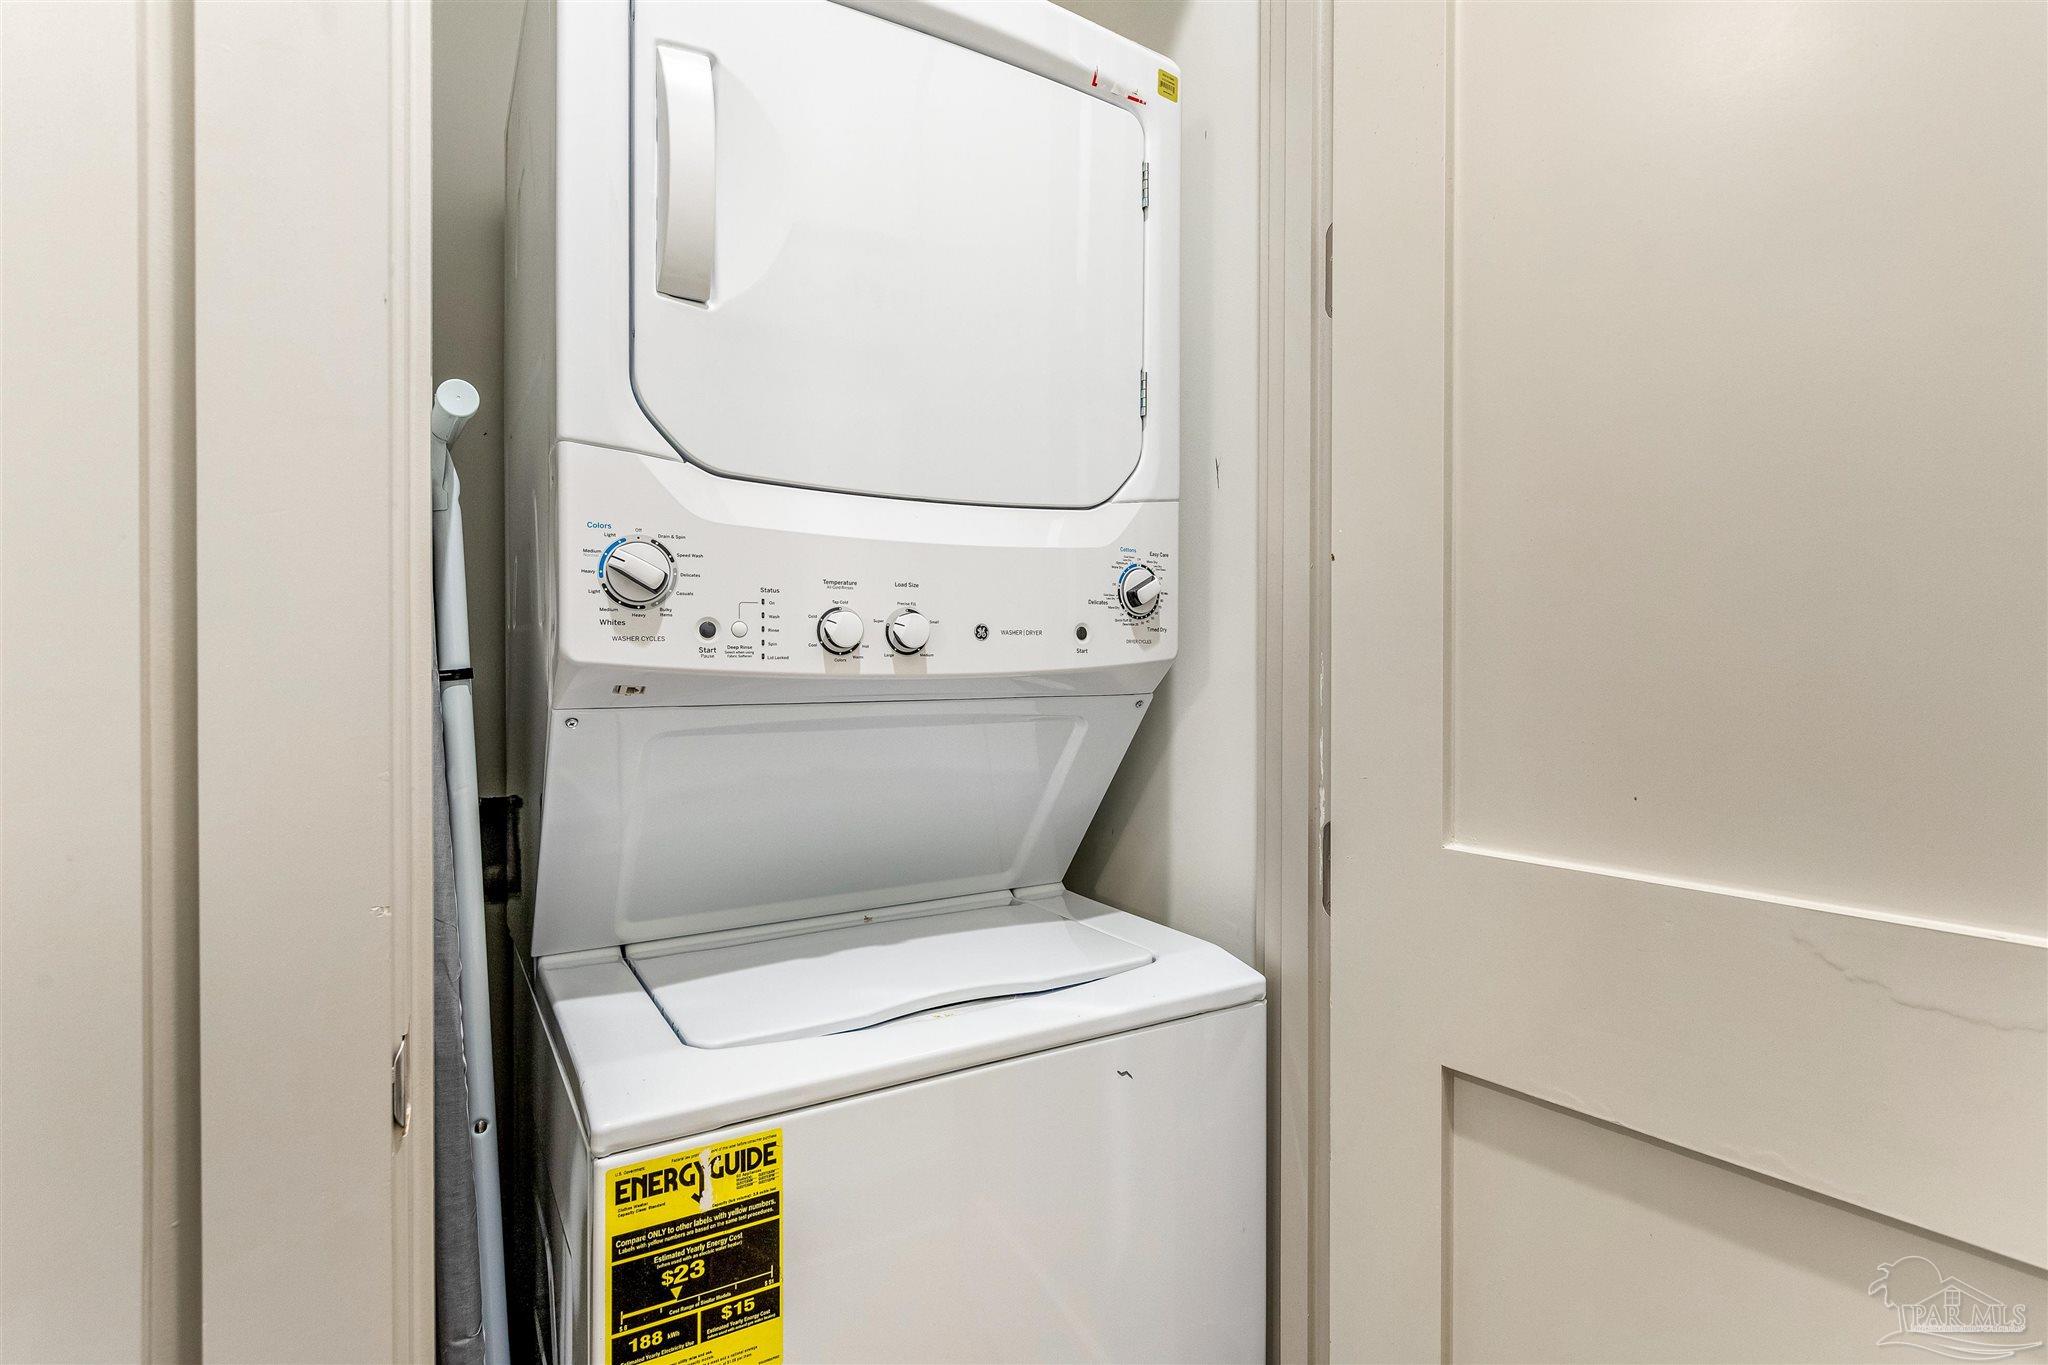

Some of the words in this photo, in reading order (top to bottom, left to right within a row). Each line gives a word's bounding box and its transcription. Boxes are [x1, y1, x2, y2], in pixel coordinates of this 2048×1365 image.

[587, 521, 612, 530] Colors
[648, 1202, 666, 1210] Standard
[615, 1235, 647, 1248] Compare
[647, 1228, 667, 1240] ONLY
[676, 1222, 693, 1232] other
[694, 1216, 713, 1227] labels
[714, 1212, 727, 1221] with
[728, 1207, 748, 1219] yellow
[748, 1199, 776, 1211] numbers.
[618, 1246, 635, 1255] Labels
[647, 1239, 664, 1248] yellow
[664, 1232, 686, 1241] numbers
[695, 1225, 709, 1234] based
[748, 1207, 774, 1219] procedures.
[653, 1249, 685, 1263] Estimated
[686, 1243, 705, 1254] Yearly
[706, 1236, 728, 1248] Energy
[729, 1232, 743, 1241] Cost
[699, 1248, 715, 1257] electric
[661, 1259, 705, 1287] $23
[680, 1305, 694, 1313] Range
[701, 1297, 715, 1305] Similar
[716, 1292, 732, 1300] Models
[721, 1297, 755, 1320] $15
[706, 1323, 729, 1334] Estimated
[730, 1318, 744, 1327] Yearly
[744, 1313, 760, 1322] Energy
[628, 1330, 663, 1353] 188
[667, 1330, 680, 1339] kWh
[646, 1351, 661, 1360] Yearly
[661, 1344, 685, 1355] Electricity
